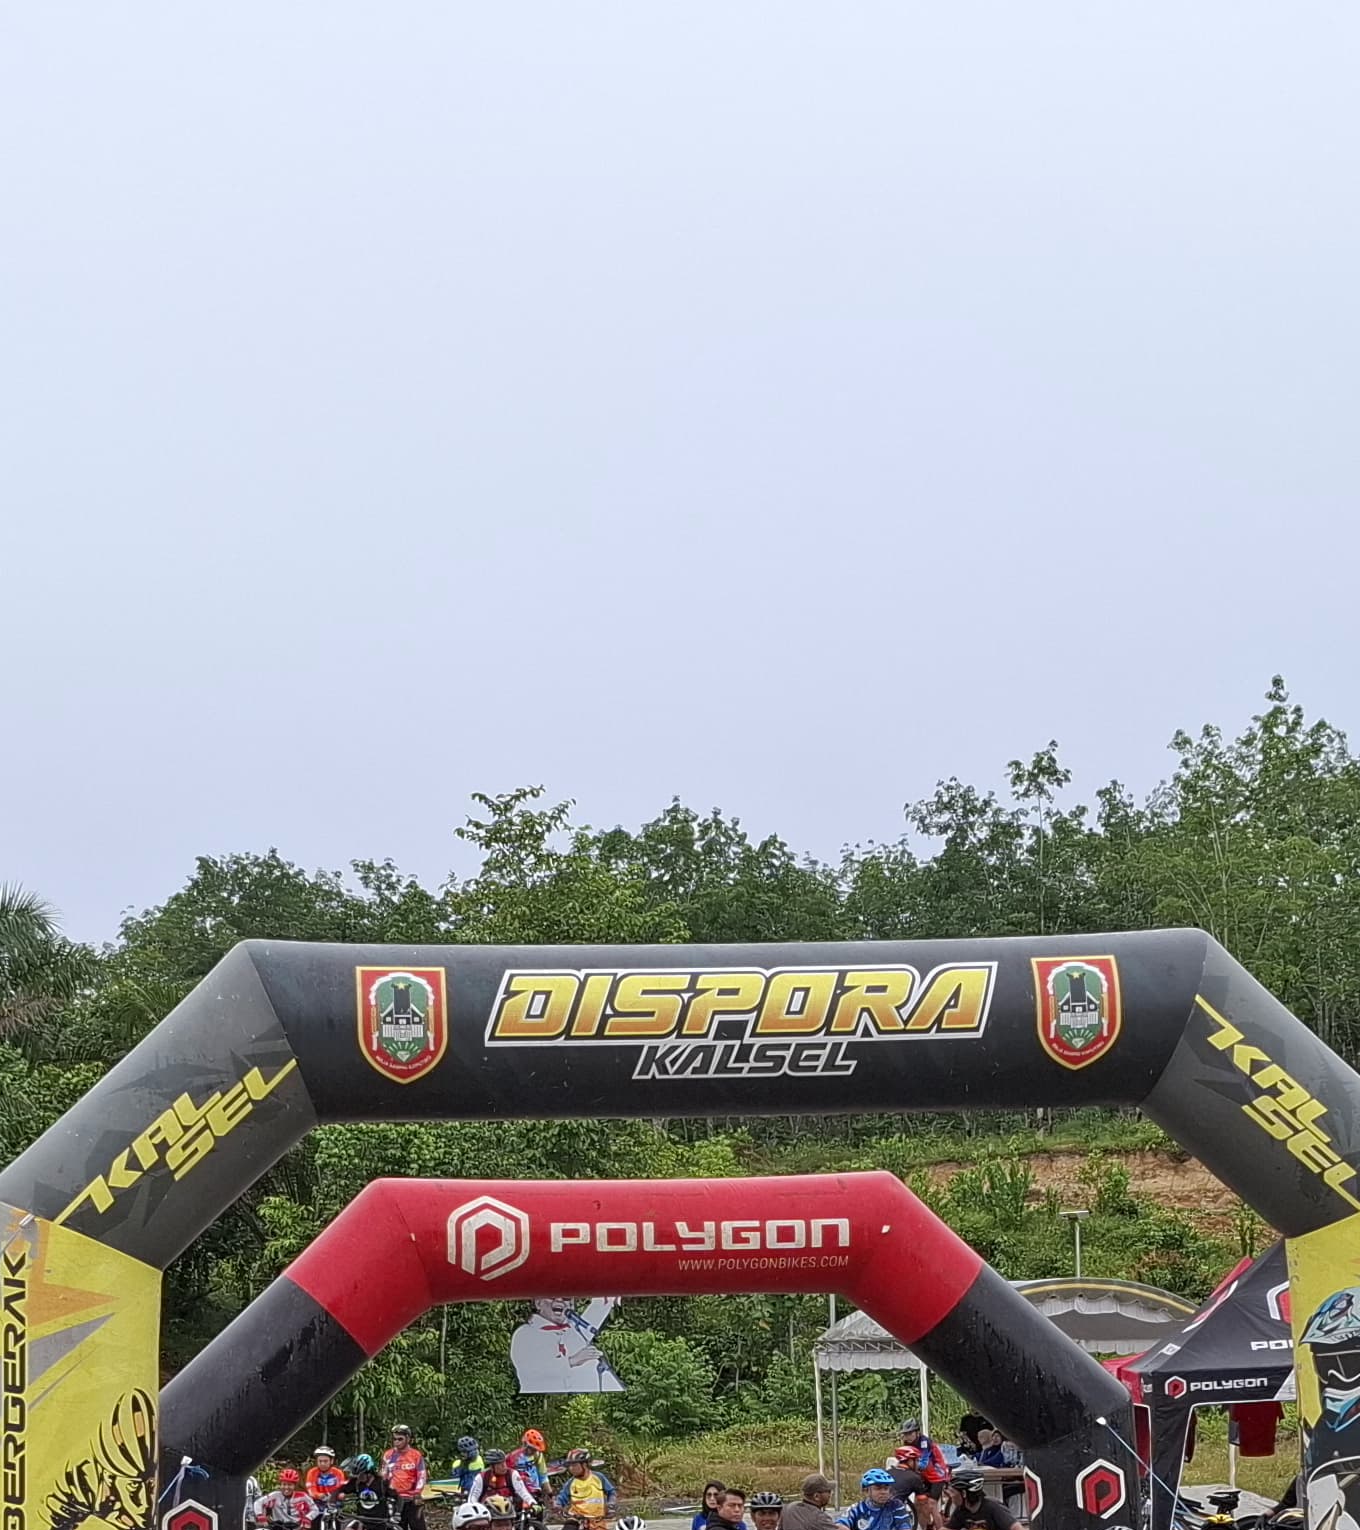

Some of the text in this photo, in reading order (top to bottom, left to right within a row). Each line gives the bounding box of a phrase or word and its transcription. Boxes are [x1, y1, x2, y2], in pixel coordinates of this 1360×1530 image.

[488, 964, 995, 1042] DISPORA
[635, 1042, 858, 1079] KALSEL
[550, 1218, 850, 1252] POLYGON
[678, 1255, 849, 1271] WWW.POLYGONBIKES.COM
[1190, 1377, 1268, 1392] POLYGON
